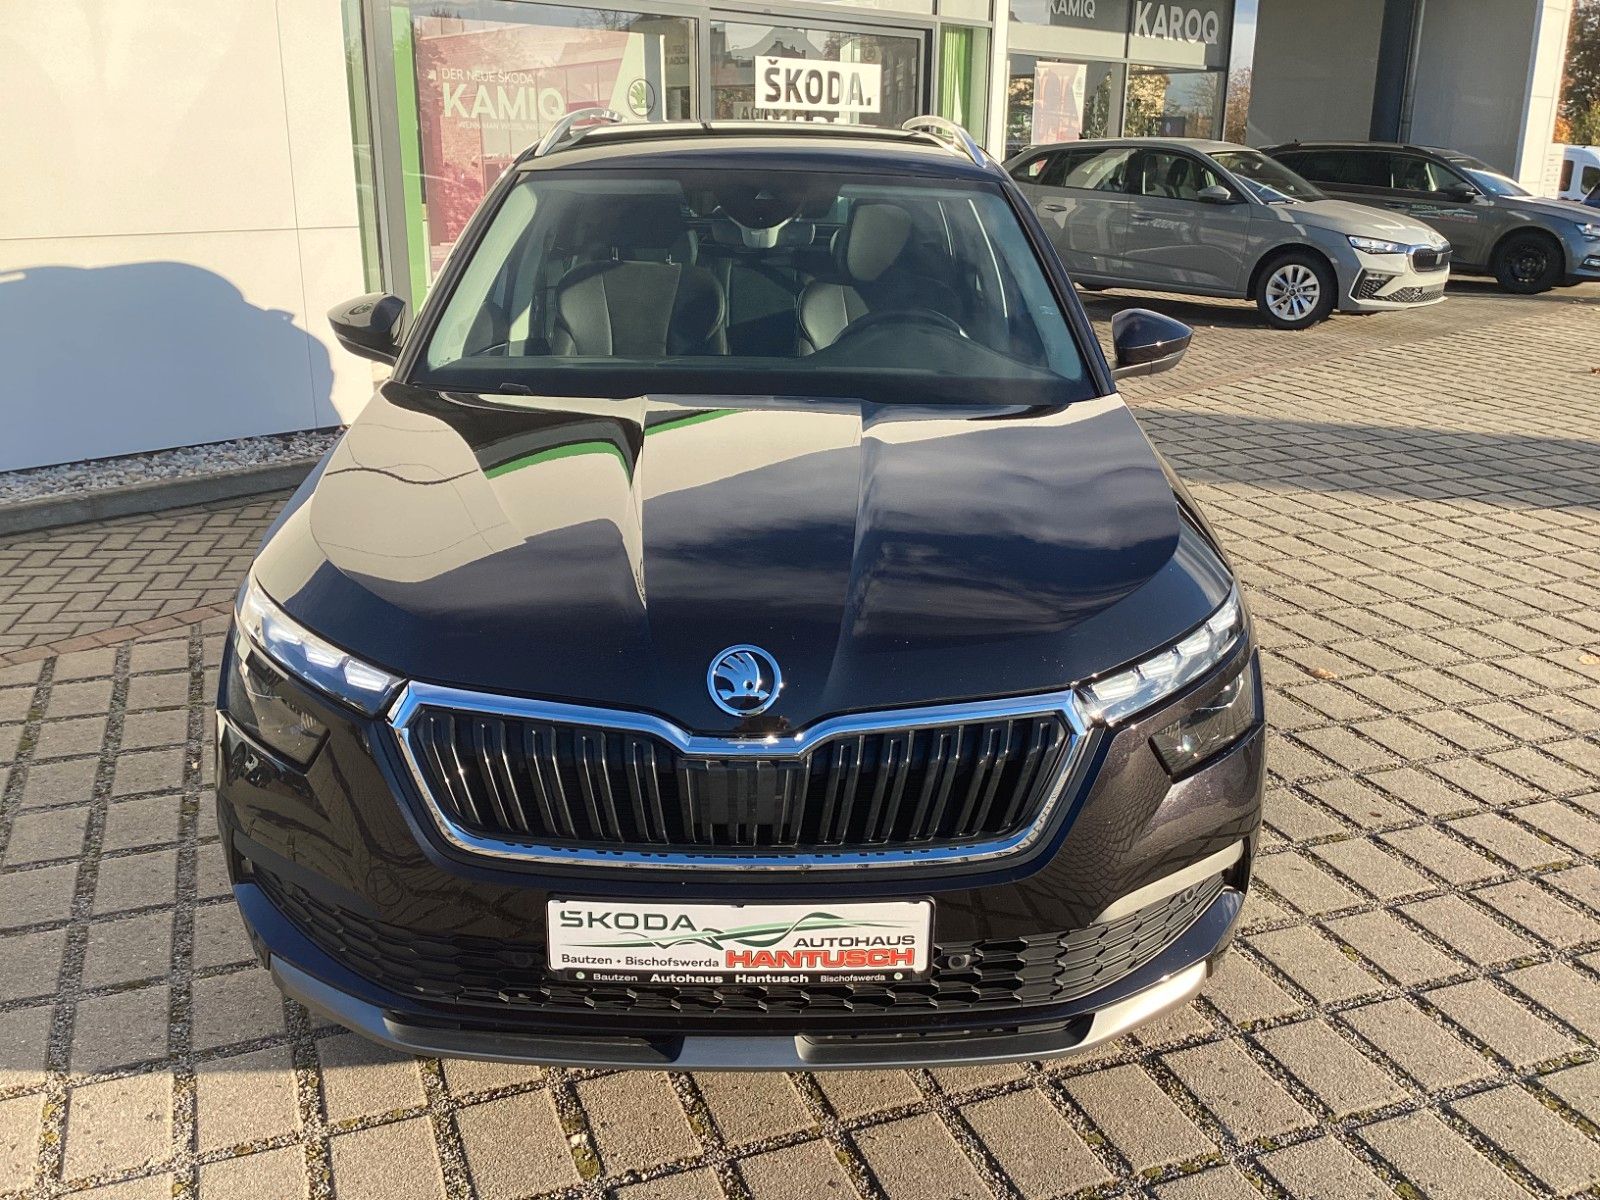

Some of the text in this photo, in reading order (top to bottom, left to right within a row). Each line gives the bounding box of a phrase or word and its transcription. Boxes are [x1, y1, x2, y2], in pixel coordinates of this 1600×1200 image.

[1134, 1, 1219, 44] KAROQ
[441, 68, 464, 80] DER
[466, 70, 496, 82] NEUE
[442, 82, 566, 121] KAMIQ
[793, 935, 916, 948] AUTOHAUS
[561, 954, 720, 968] Bautzen Bischofswerda
[725, 948, 916, 968] HANTUSCH
[593, 973, 886, 983] Bautzen Autohaus Hantusch Bischofswerda
